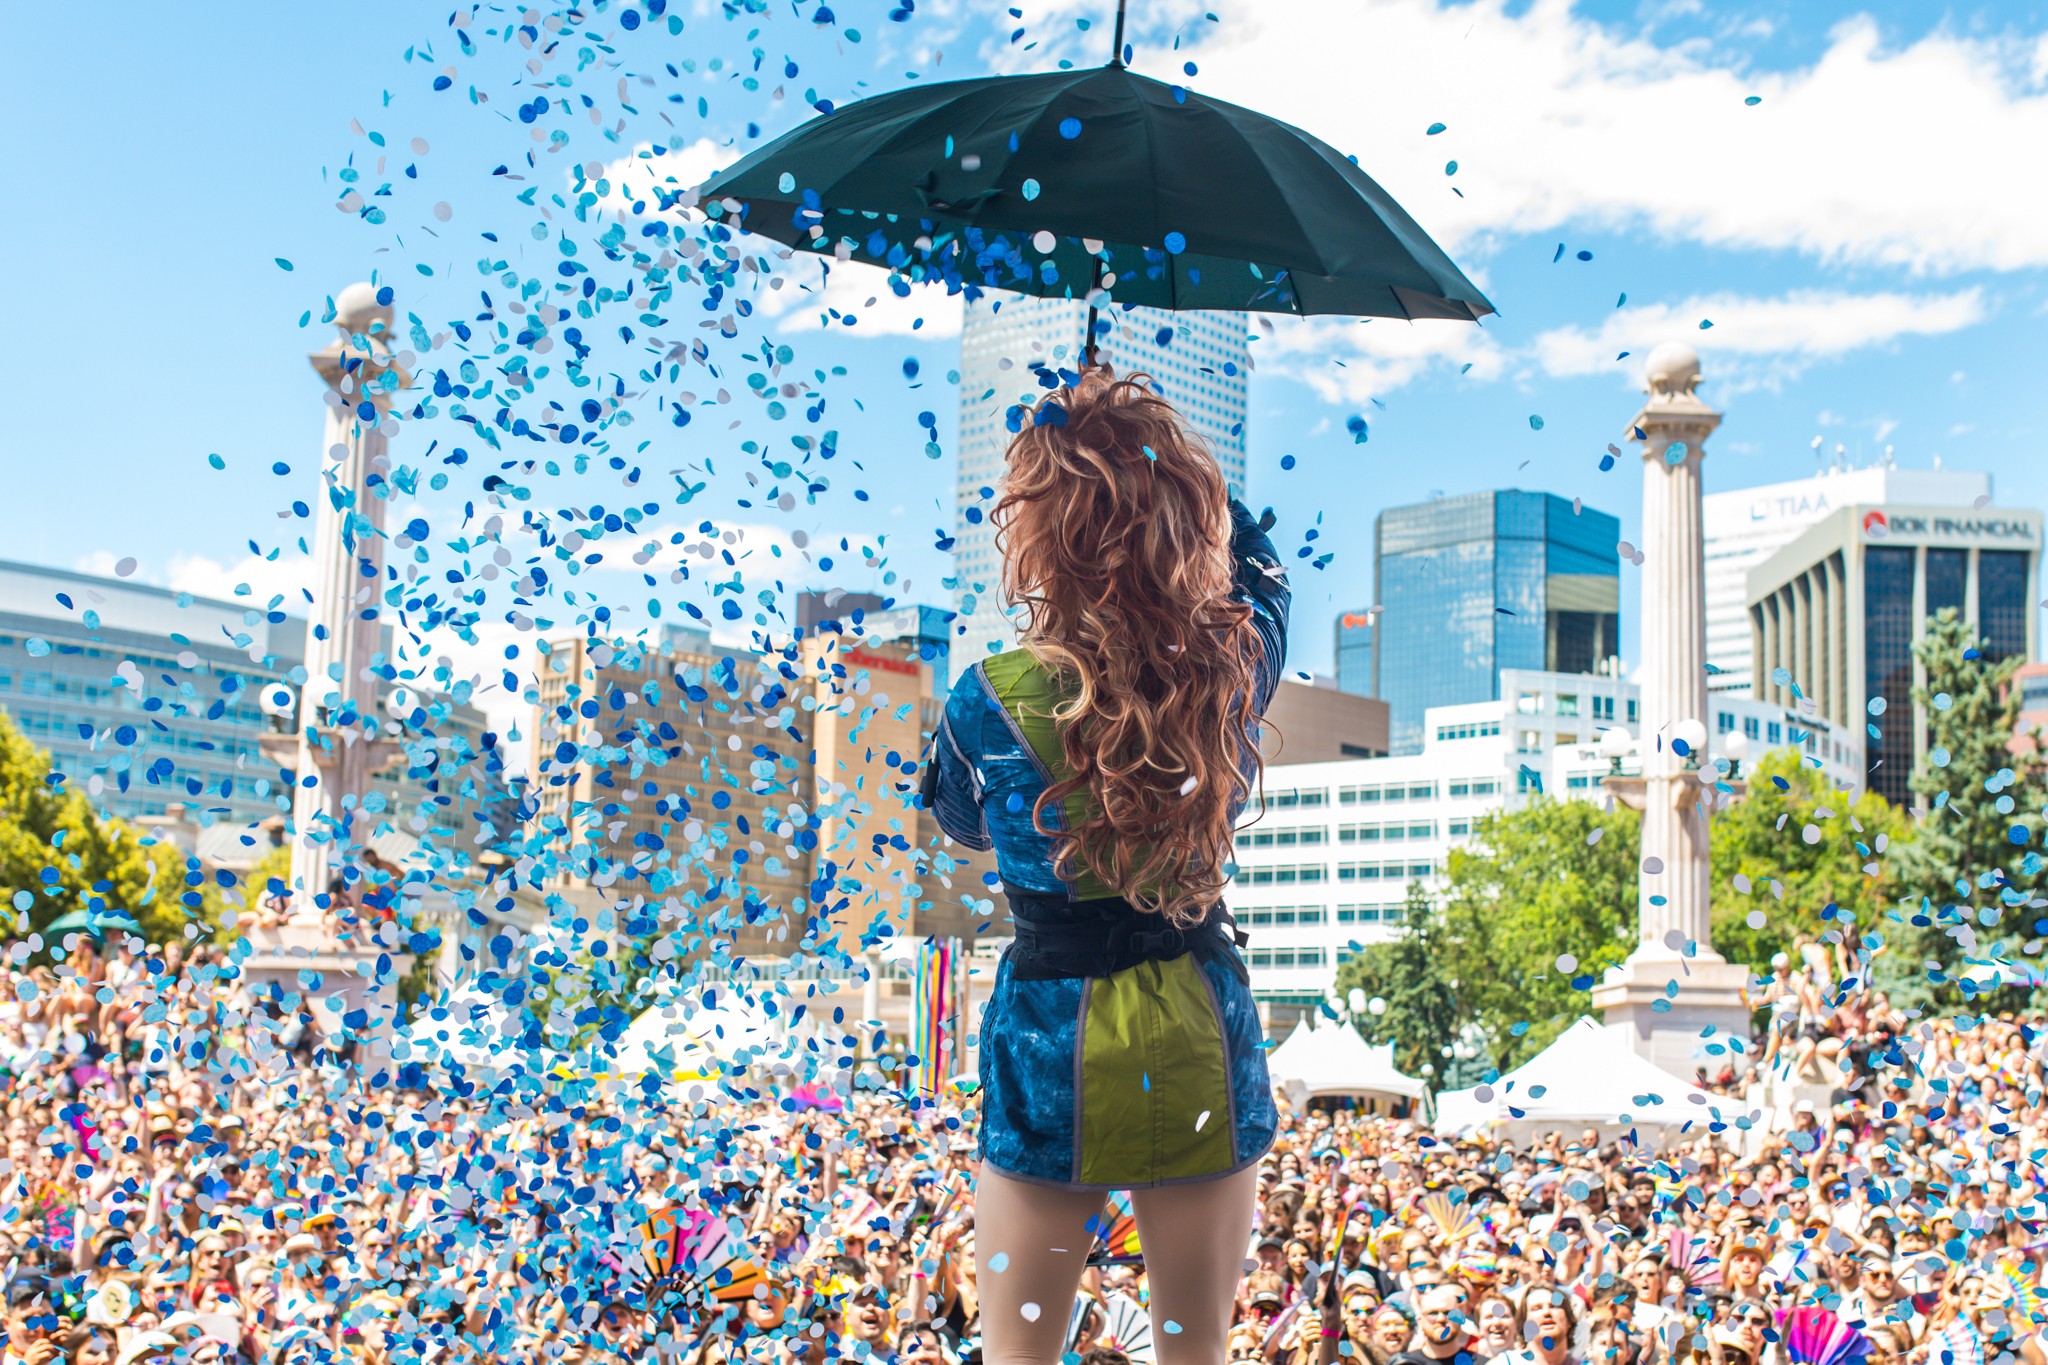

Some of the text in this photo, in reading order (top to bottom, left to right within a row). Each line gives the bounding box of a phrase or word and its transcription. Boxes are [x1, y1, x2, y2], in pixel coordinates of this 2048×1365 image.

[1776, 492, 1829, 517] TIAA
[1890, 515, 2033, 538] BOK FINANCIAL
